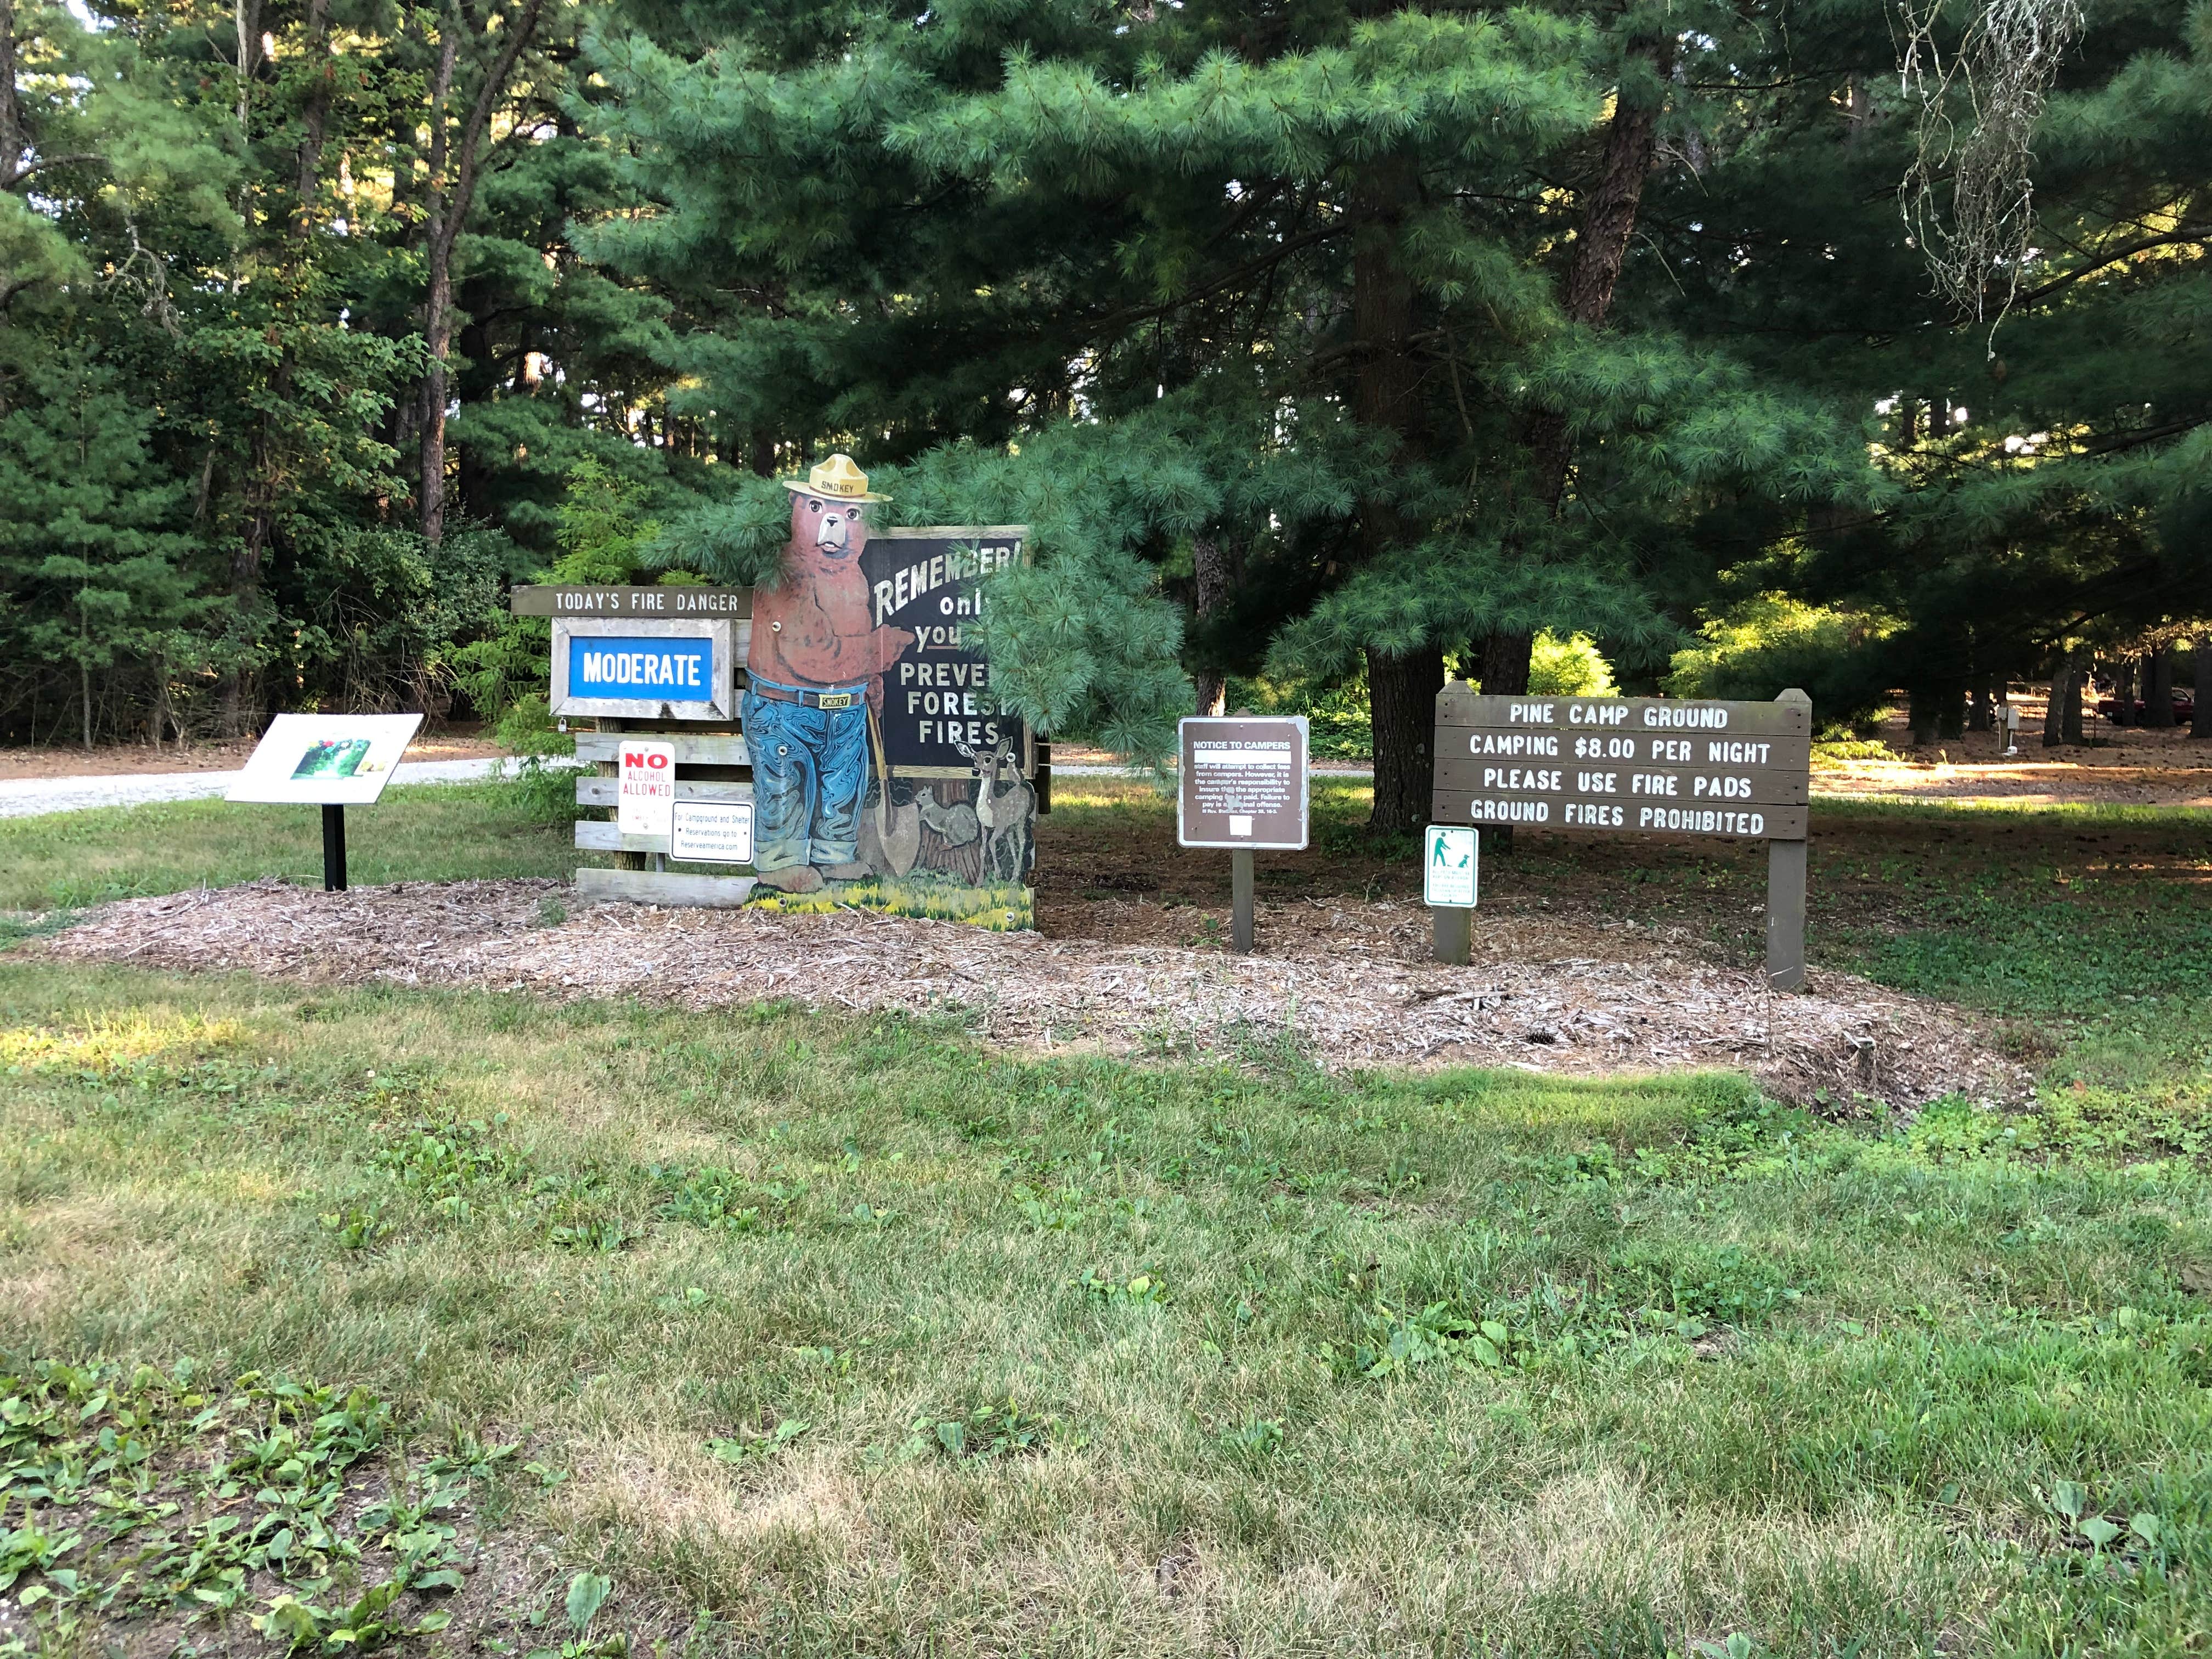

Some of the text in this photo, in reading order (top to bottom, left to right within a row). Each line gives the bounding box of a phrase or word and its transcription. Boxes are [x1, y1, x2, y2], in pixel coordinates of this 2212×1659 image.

[821, 481, 854, 493] SMOKEY
[556, 592, 738, 611] TODAY'S FIRE DANGER
[940, 588, 990, 615] onl
[915, 627, 961, 653] you
[583, 652, 701, 686] MODERATE
[900, 662, 989, 686] PREVE
[823, 698, 848, 707] SMOKEY
[1510, 703, 1728, 728] PINE CAMP GROUND
[919, 720, 999, 745] FIRES
[1470, 735, 1770, 763] CAMPING $8.00 PER NIGHT
[625, 753, 668, 769] NO
[628, 771, 665, 782] ALCOHOL
[1484, 768, 1751, 798] PLEASE USE FIRE PADS
[623, 783, 670, 797] ALLOWED
[685, 812, 718, 823] Campground
[732, 815, 750, 824] Shelter
[1471, 799, 1764, 834] GROUND FIRES PROHIBITED
[686, 828, 720, 837] Reservations
[681, 840, 738, 850] Reserveamericacom
